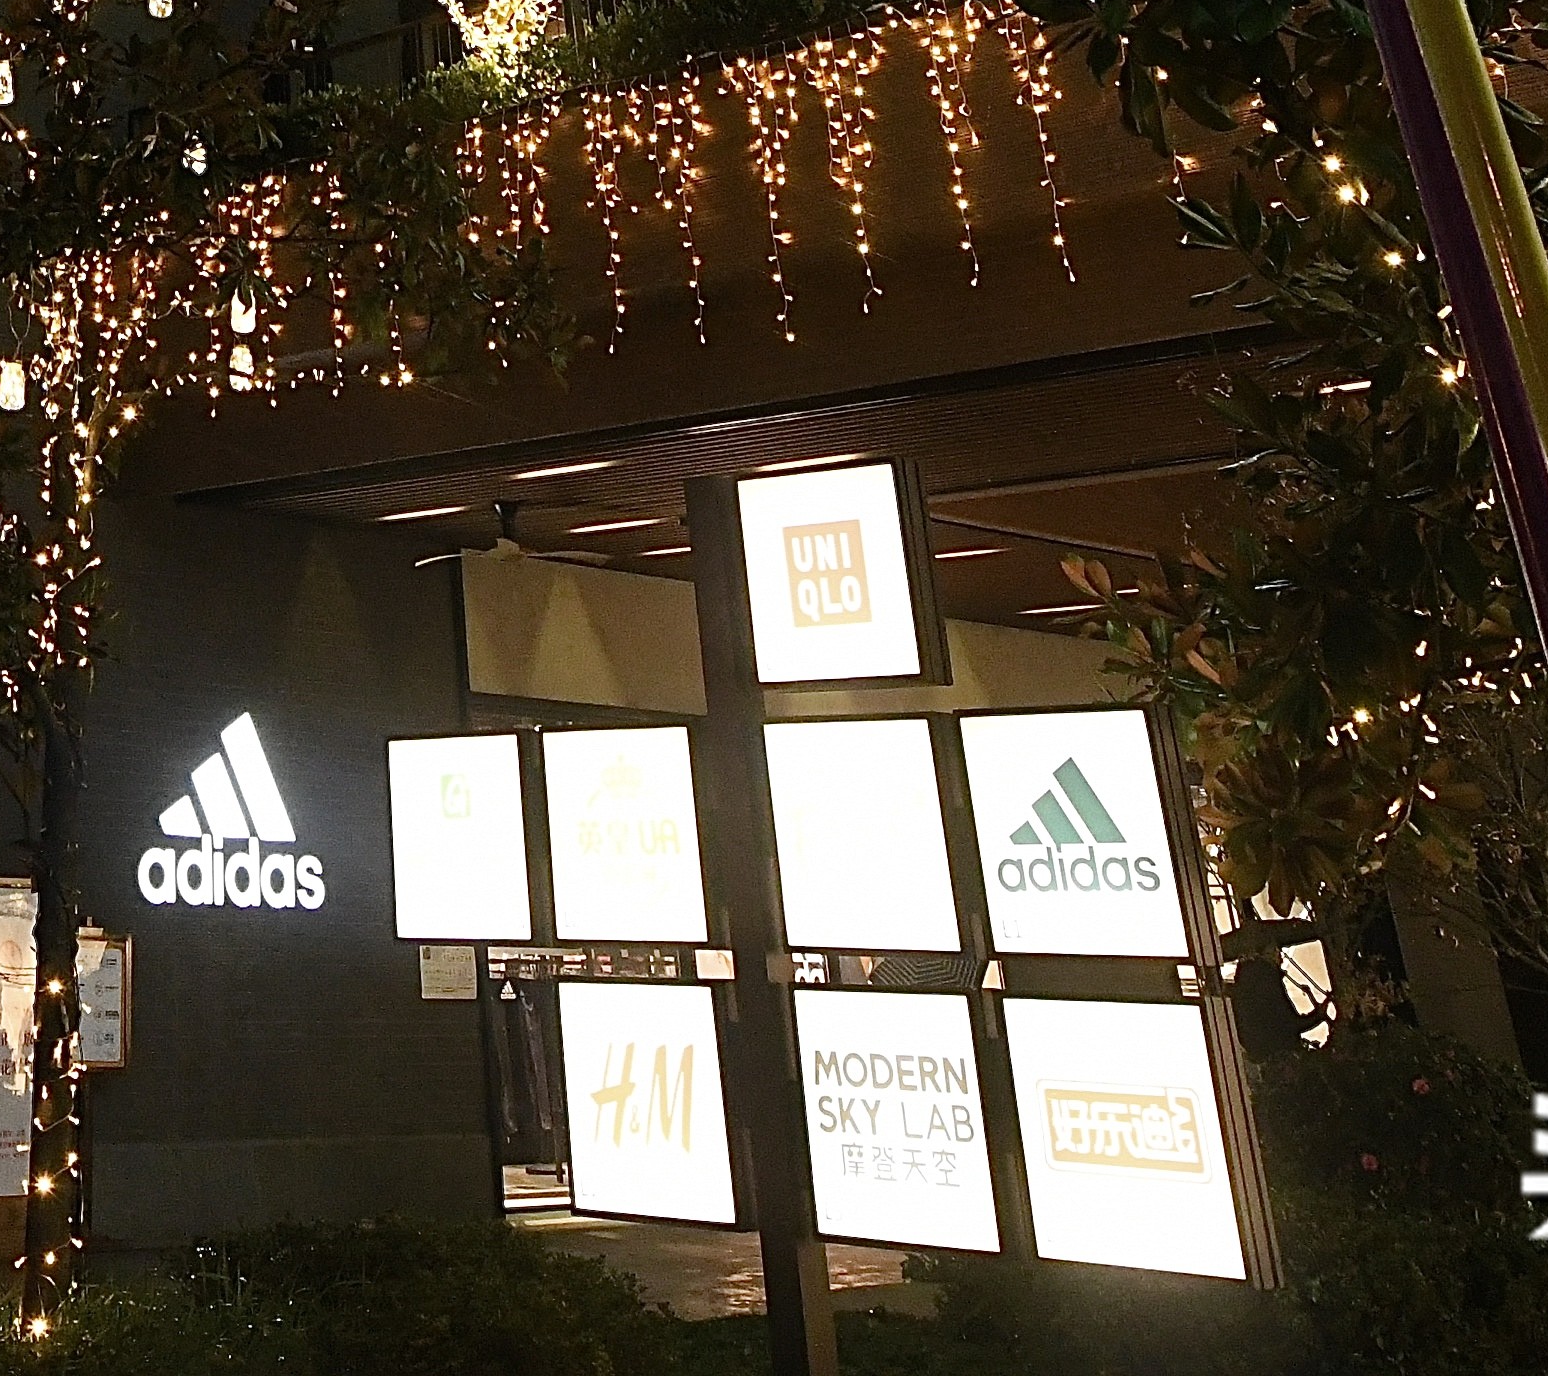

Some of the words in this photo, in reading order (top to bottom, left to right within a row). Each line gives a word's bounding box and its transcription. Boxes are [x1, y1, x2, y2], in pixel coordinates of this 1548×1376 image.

[791, 532, 852, 573] UNI
[797, 574, 862, 623] QLO
[137, 833, 326, 910] adidas
[998, 846, 1161, 892] adidas
[814, 1050, 969, 1095] MODERN
[590, 1041, 694, 1153] H&M
[818, 1095, 881, 1136] SKY
[901, 1101, 975, 1143] LAB
[841, 1143, 961, 1188] 摩登天空
